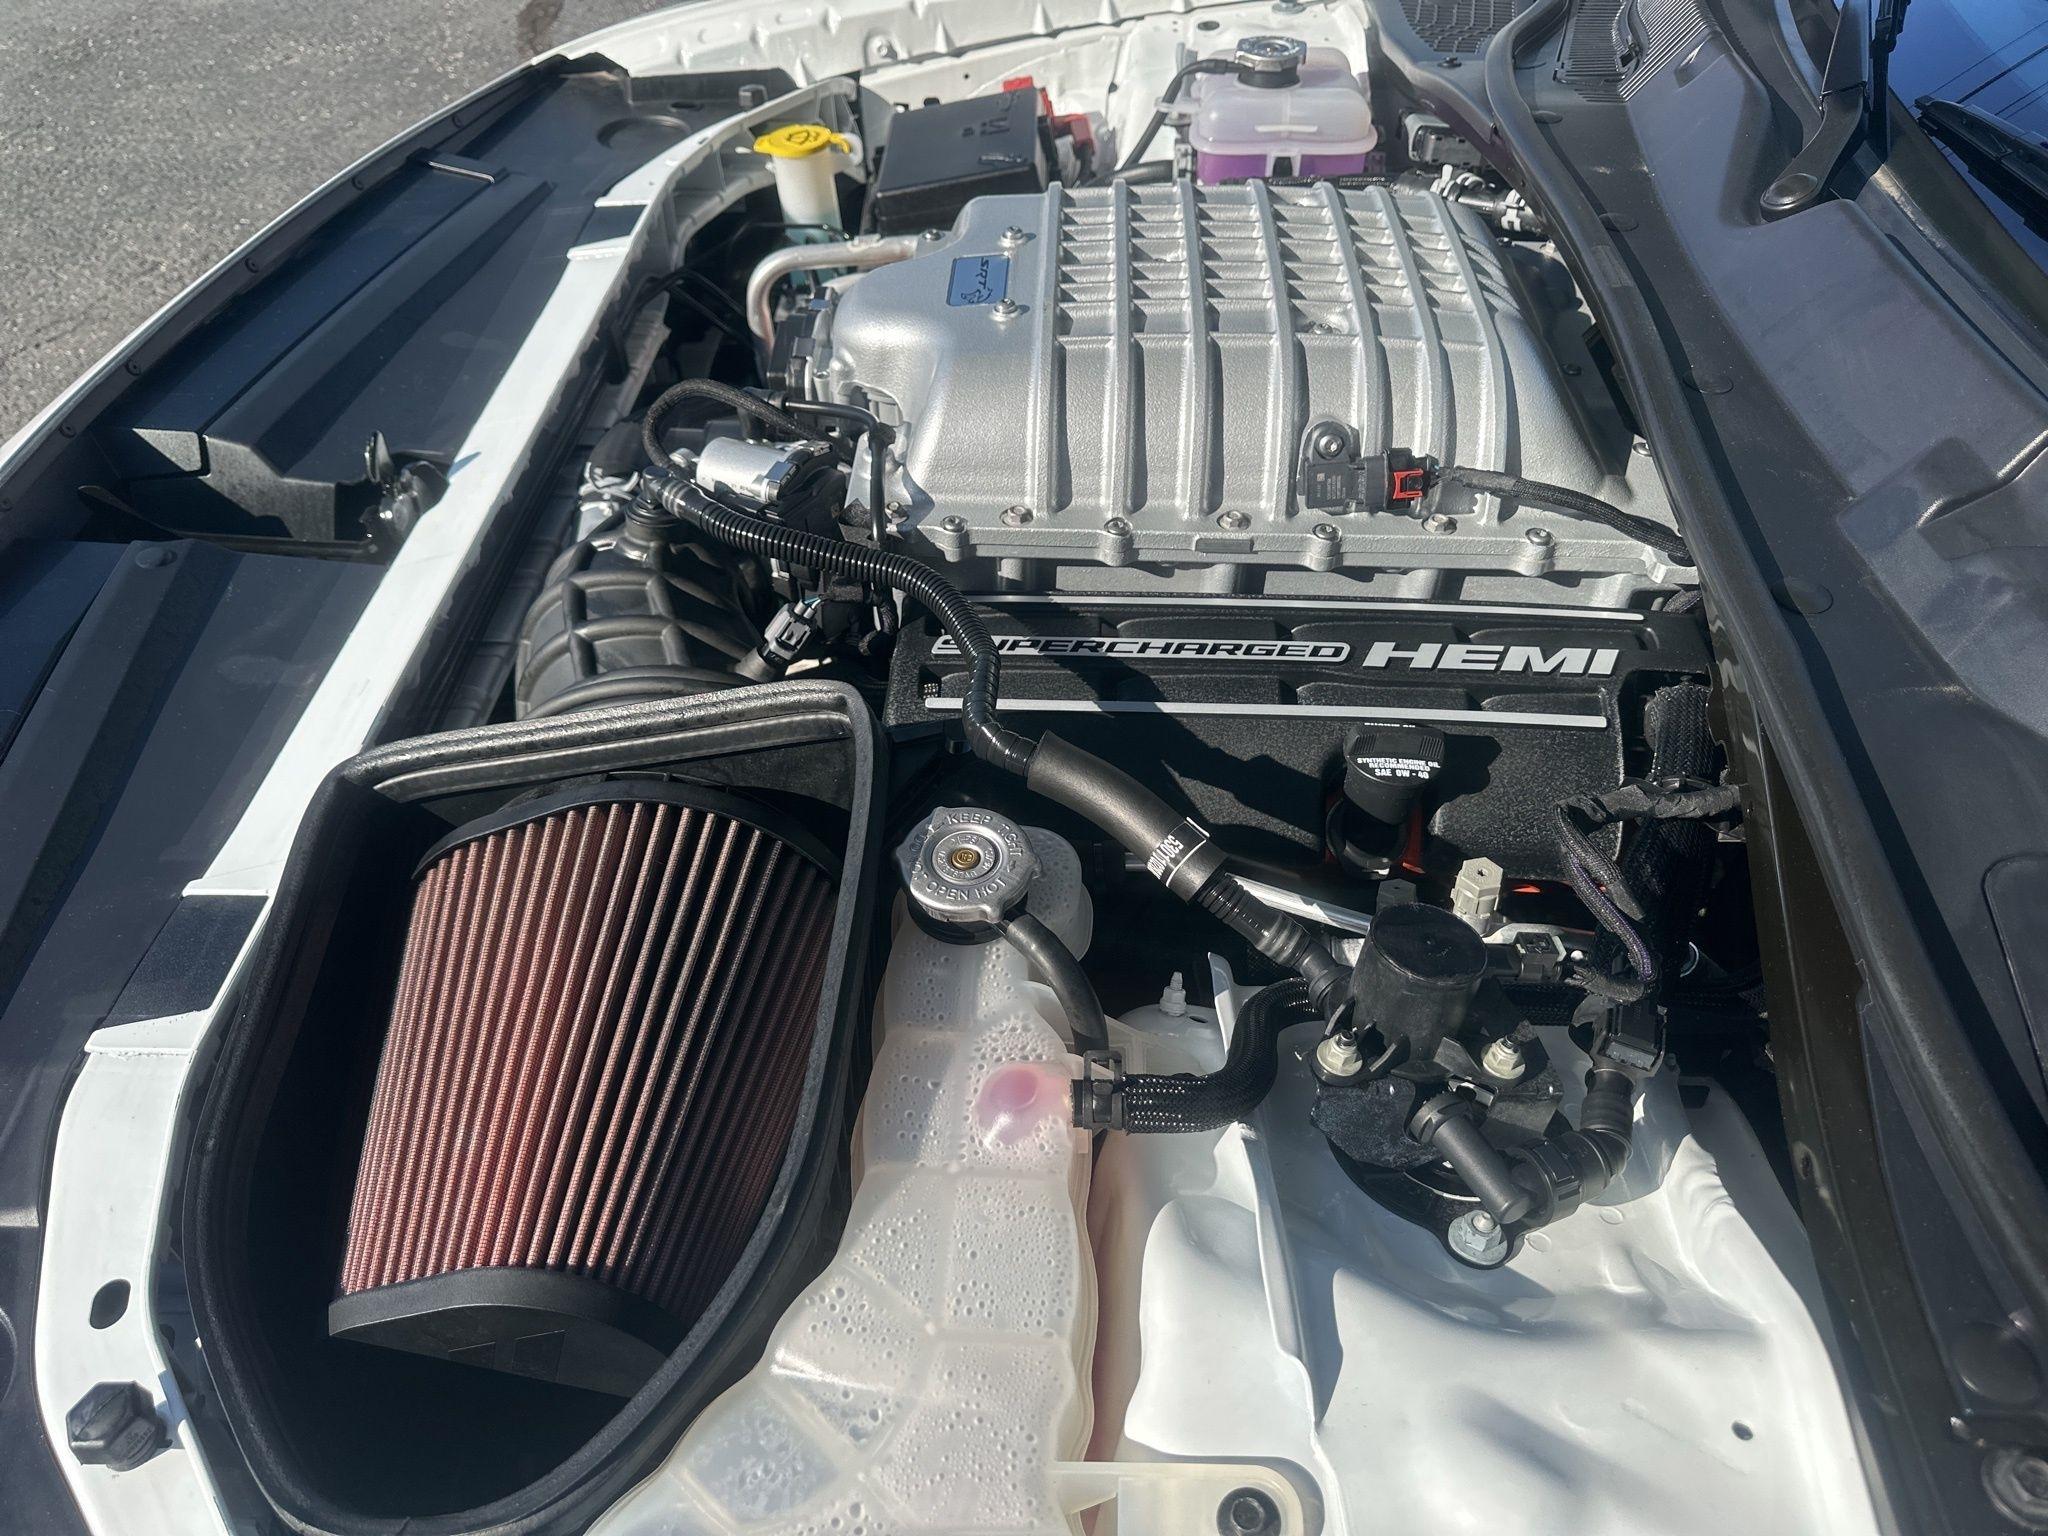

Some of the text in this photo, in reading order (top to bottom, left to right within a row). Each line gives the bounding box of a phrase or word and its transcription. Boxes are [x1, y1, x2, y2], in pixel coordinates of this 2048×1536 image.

[1362, 641, 1620, 675] HEMI
[1427, 760, 1441, 769] OIL
[1374, 768, 1393, 777] SAE
[945, 811, 993, 826] KEEP
[925, 880, 971, 901] OPEN
[974, 877, 1007, 899] HOT
